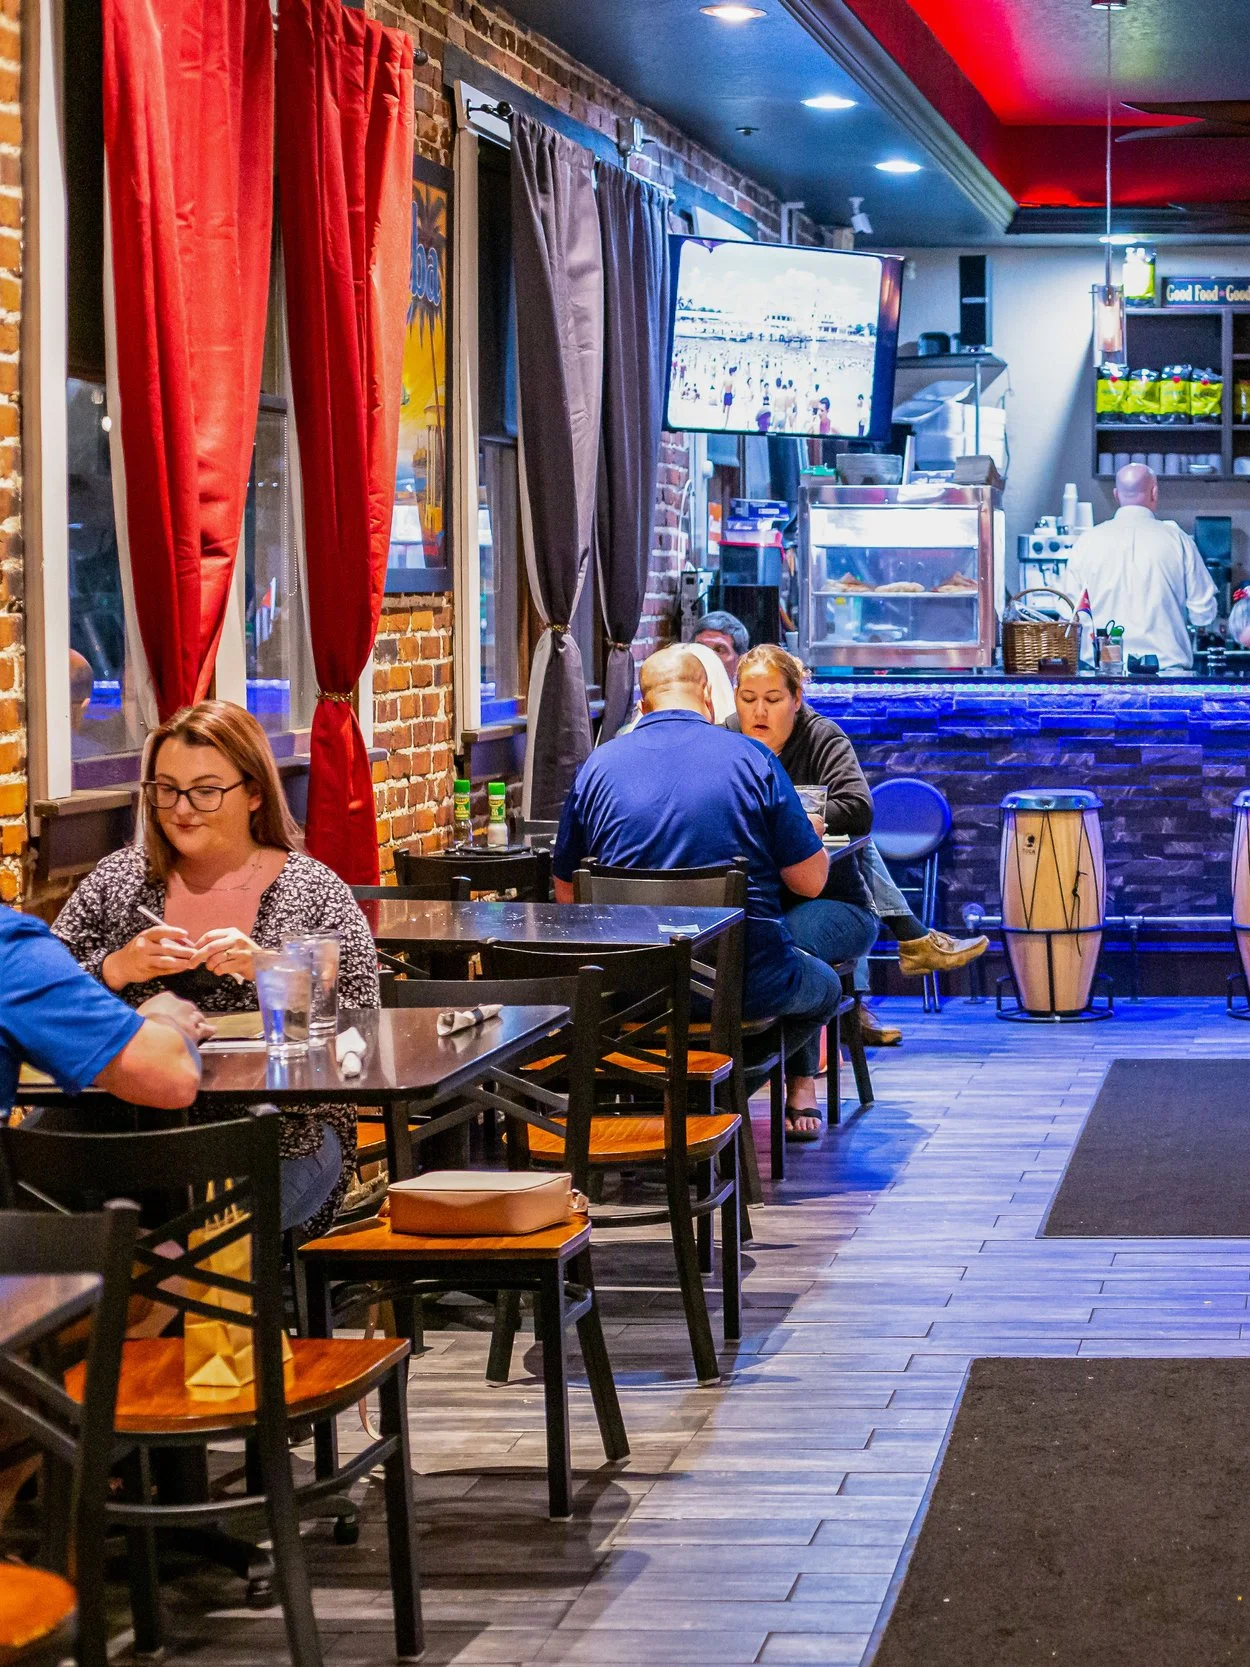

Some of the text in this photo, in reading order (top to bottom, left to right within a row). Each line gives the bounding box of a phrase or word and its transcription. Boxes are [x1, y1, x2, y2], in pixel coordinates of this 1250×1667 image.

[408, 200, 441, 307] ba
[1166, 284, 1193, 302] Good
[1194, 284, 1219, 302] Food
